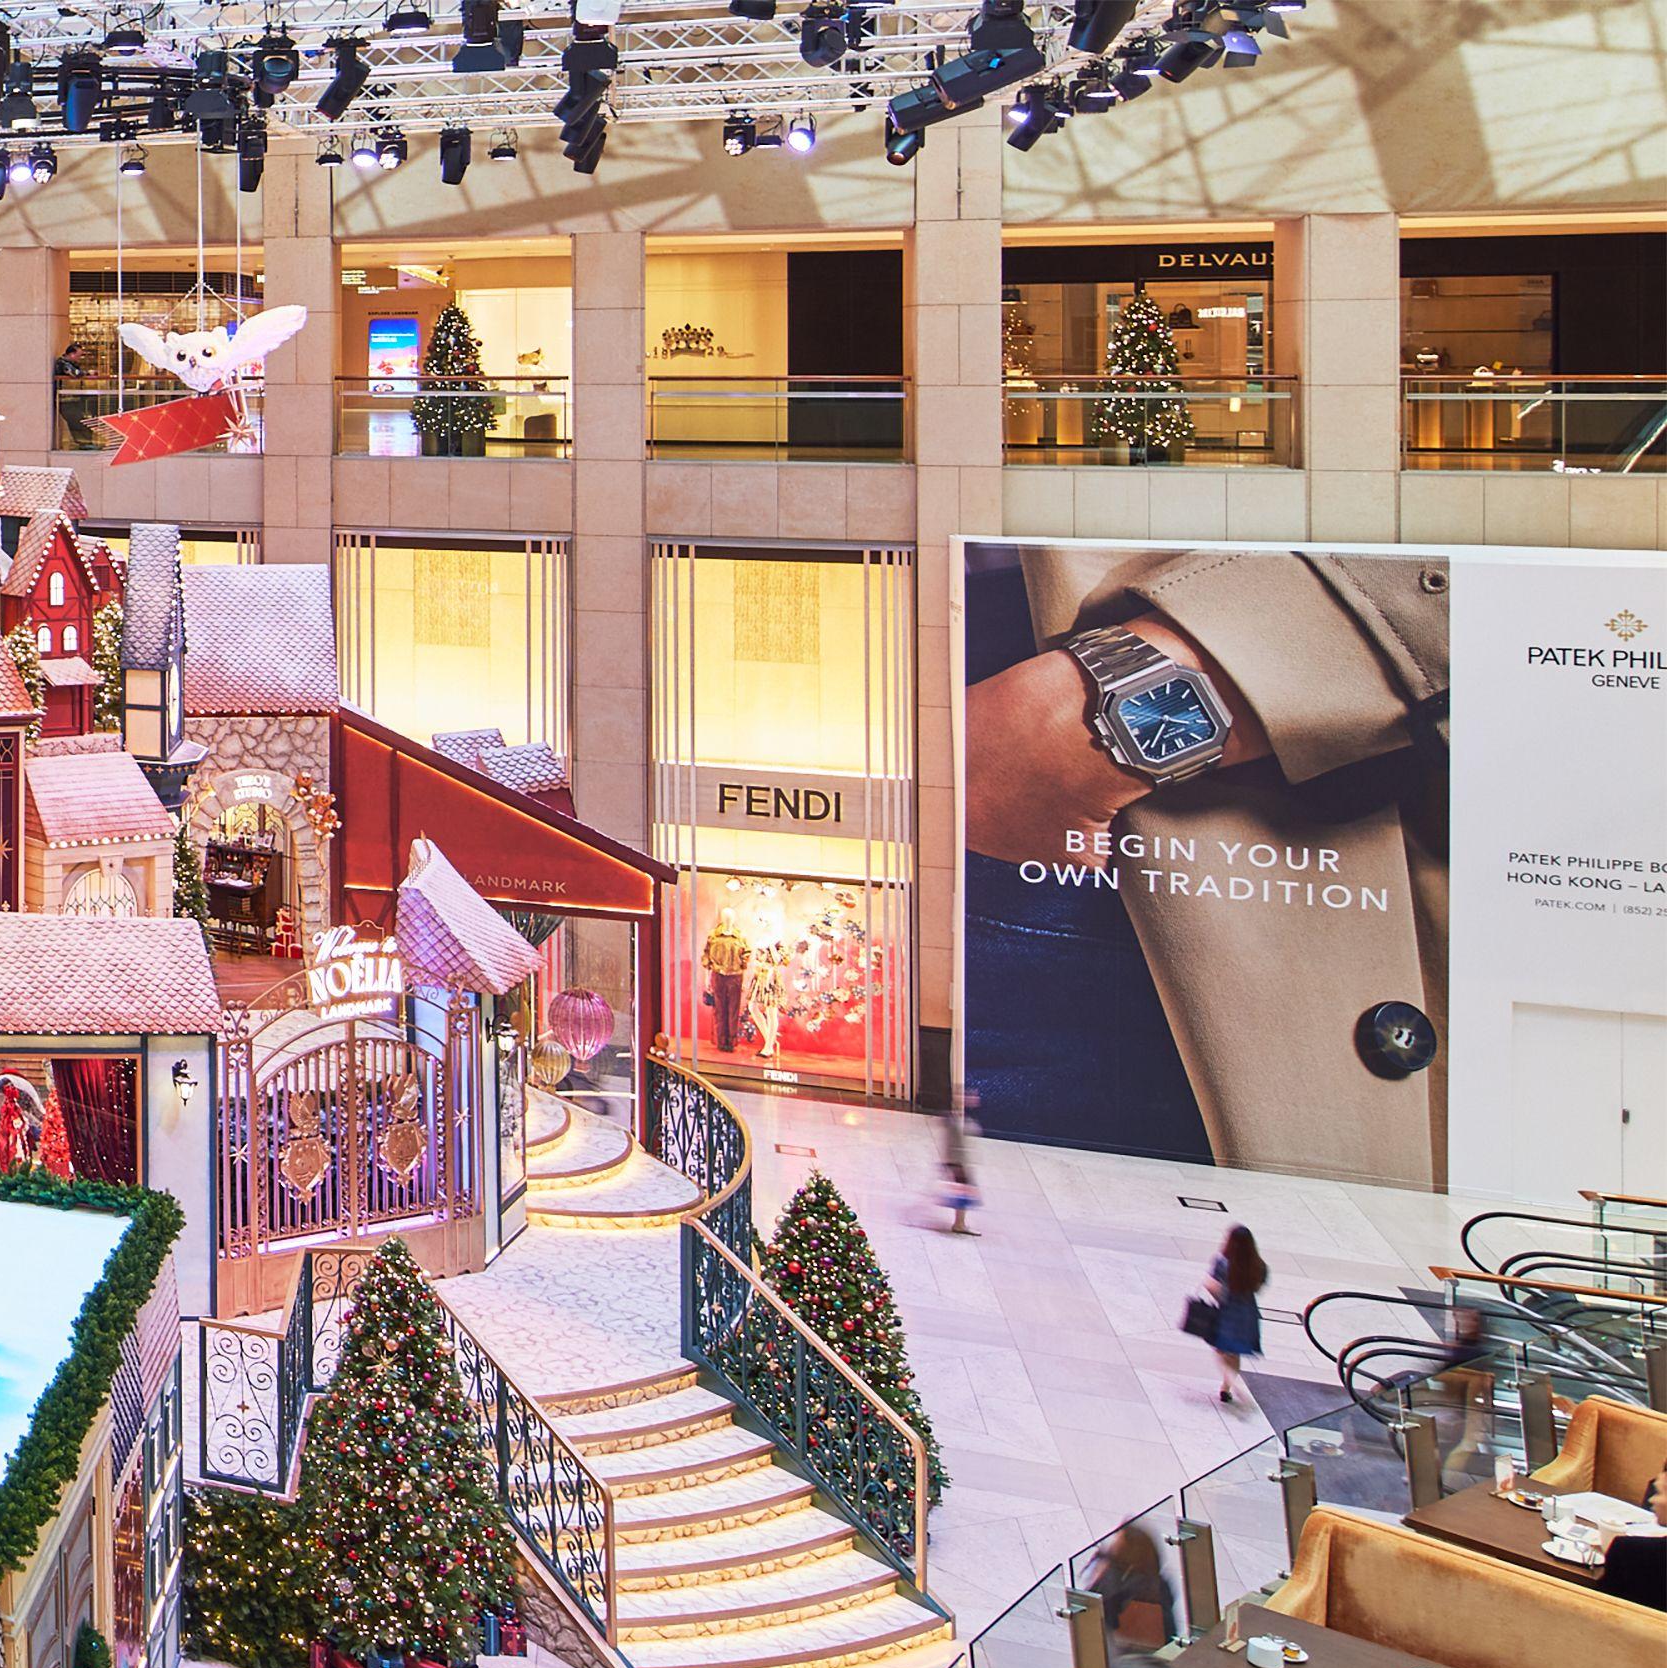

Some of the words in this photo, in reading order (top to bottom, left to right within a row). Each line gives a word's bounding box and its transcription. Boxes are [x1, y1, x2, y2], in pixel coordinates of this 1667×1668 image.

[1158, 253, 1274, 268] DELVAU
[1528, 646, 1605, 667] PATEK
[1612, 650, 1667, 670] PHIL
[1591, 674, 1661, 689] GENEVE
[718, 782, 841, 823] FENDI
[1066, 829, 1195, 862] BEGIN
[1218, 840, 1341, 873] YOUR
[1508, 852, 1561, 867] PATEK
[1567, 856, 1644, 873] PHILIPPE
[1018, 859, 1120, 891] OWN
[1140, 869, 1388, 913] TRADITION
[1507, 871, 1562, 886] HONG
[1568, 876, 1622, 890] KONG
[1534, 898, 1606, 912] PATEK.COM
[1623, 905, 1652, 916] (852)
[320, 997, 393, 1019] LANDMARK
[763, 1070, 798, 1083] FENDI
